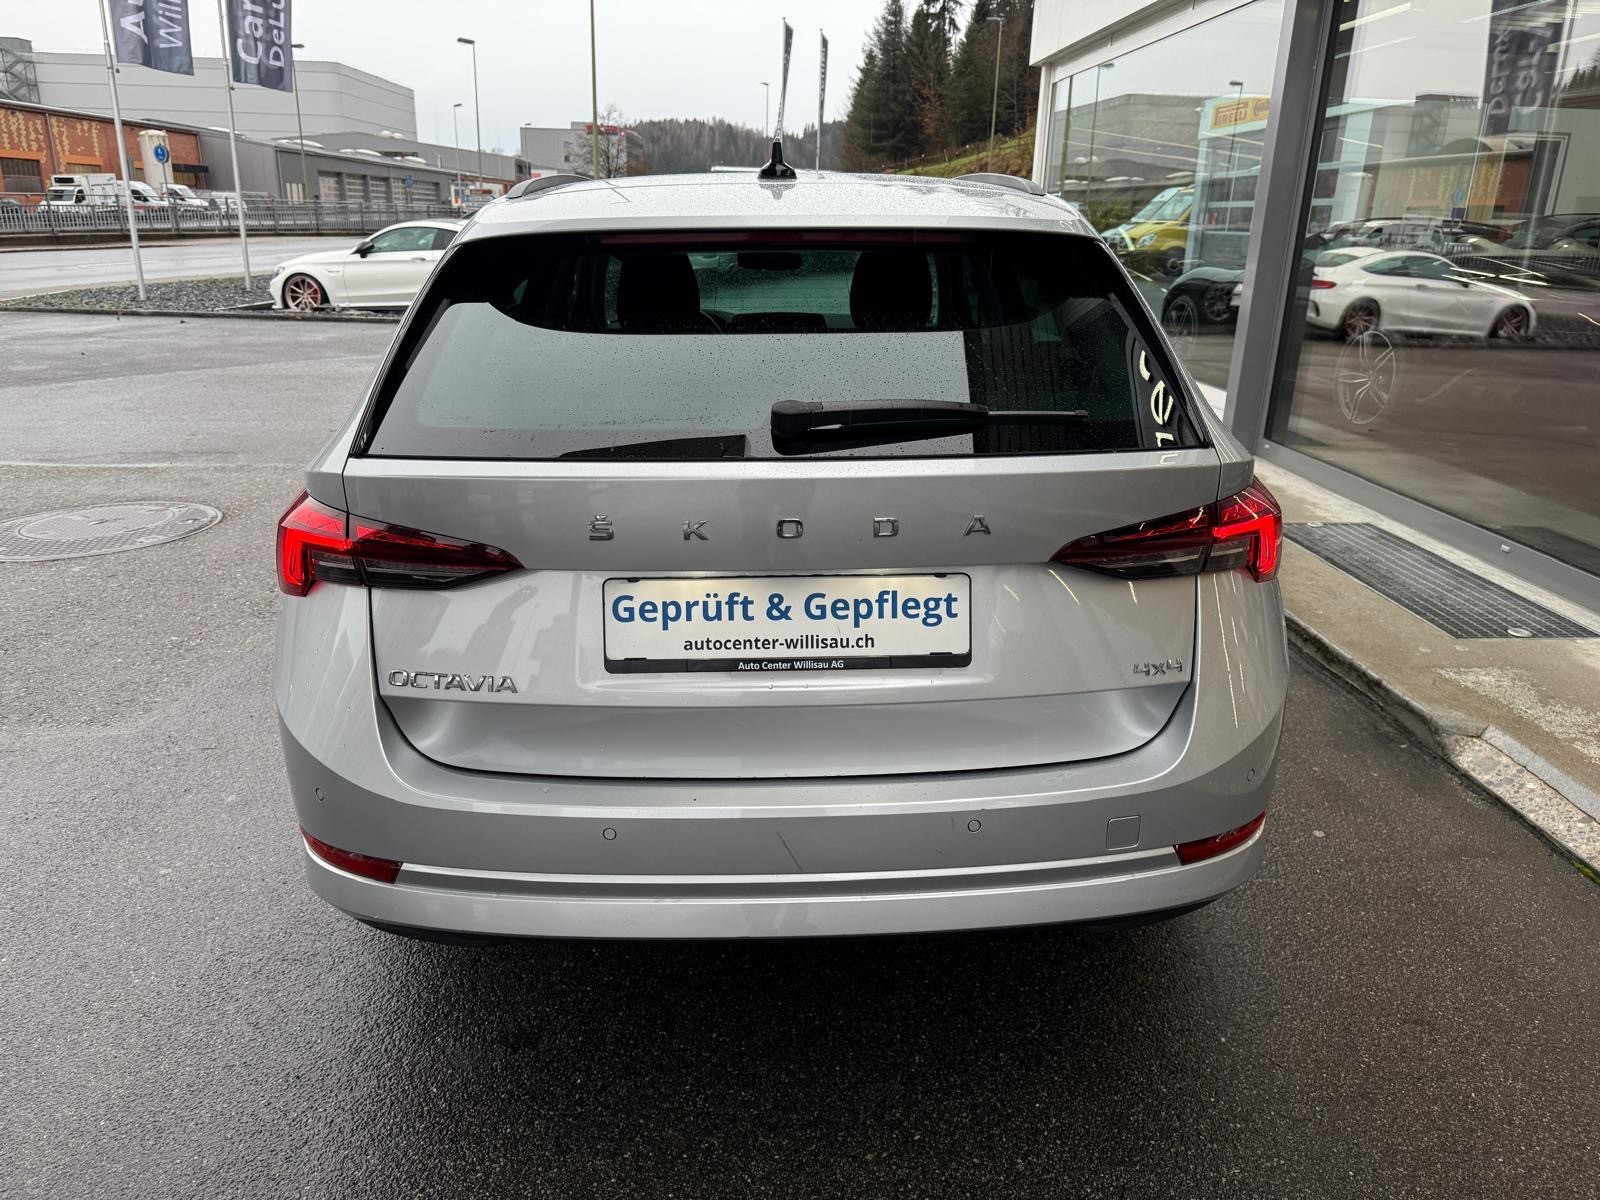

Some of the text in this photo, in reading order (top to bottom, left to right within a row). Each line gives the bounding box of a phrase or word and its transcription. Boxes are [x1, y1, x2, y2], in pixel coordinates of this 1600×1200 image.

[120, 0, 148, 44] A
[588, 514, 992, 541] ŠKODA
[611, 590, 959, 631] Geprüft & Gepflegt
[683, 634, 875, 651] autocenter-willisau.ch
[738, 660, 844, 671] Auto Center Willisau AG
[388, 669, 518, 694] OCTAVIA
